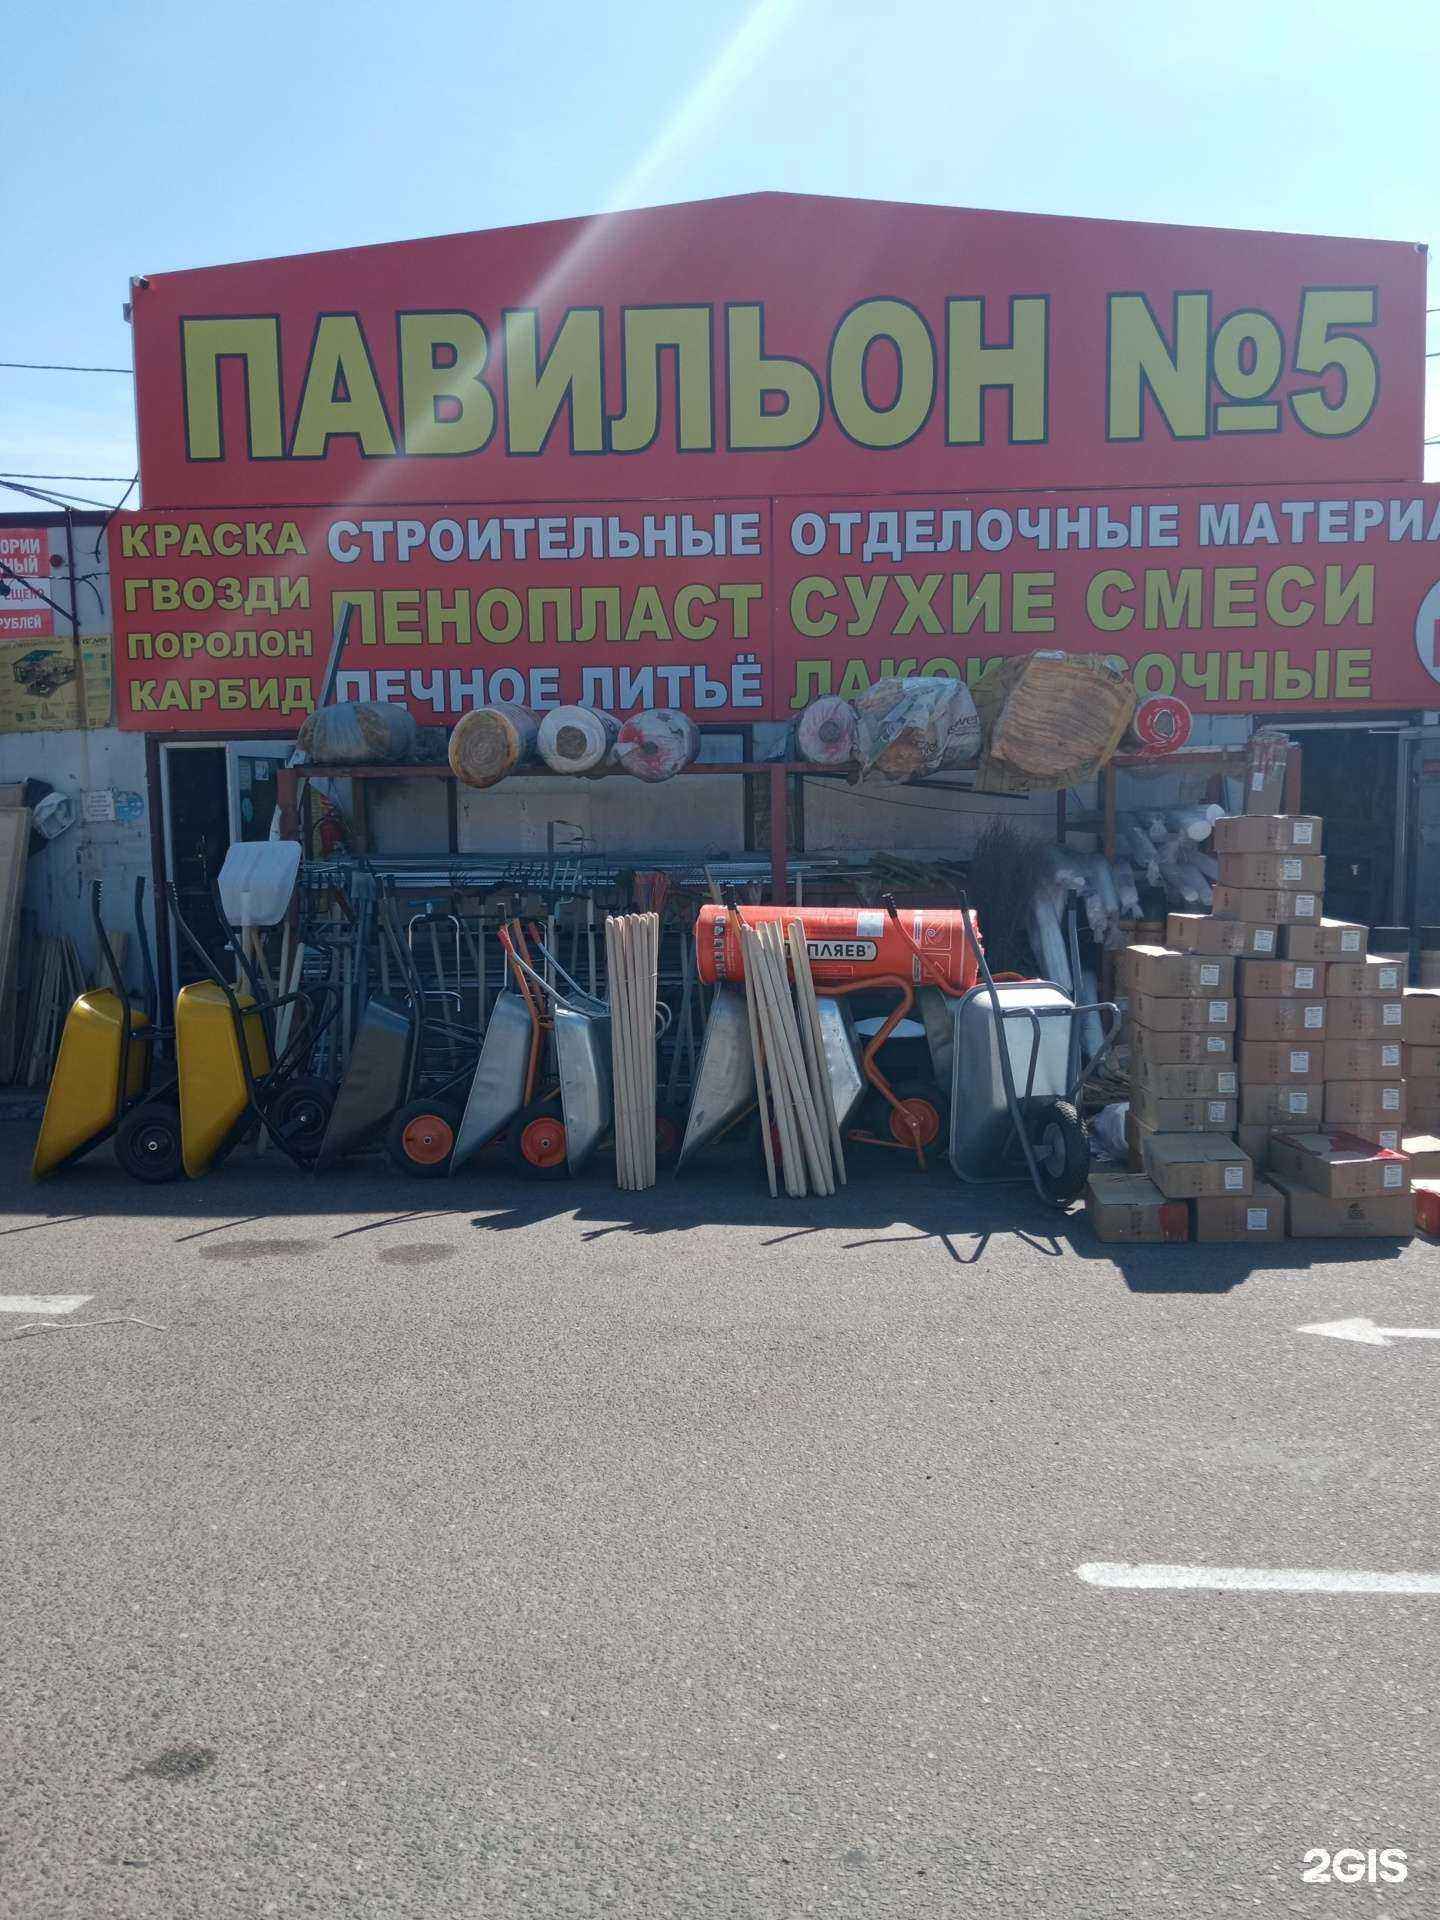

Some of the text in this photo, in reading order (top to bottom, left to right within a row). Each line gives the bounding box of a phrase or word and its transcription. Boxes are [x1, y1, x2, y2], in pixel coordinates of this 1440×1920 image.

[180, 285, 1381, 462] ПАВИЛЬОН №5
[120, 521, 308, 558] КРАСКА
[326, 512, 762, 565] СТРОИТЕЛЬНЫЕ
[789, 504, 1181, 563] ОТДЕЛОЧНЫЕ
[0, 555, 38, 574] НЫЙ
[123, 576, 312, 617] ГВОЗДИ
[330, 582, 763, 646] ПЕНОПЛАСТ
[789, 563, 1377, 639] СУХИЕ СМЕСИ
[126, 629, 314, 660] ПОРОЛОН
[129, 676, 315, 715] КАРБИД
[335, 653, 763, 713] ПЕЧНОЕ ЛИТЬЁ
[790, 646, 1373, 711] ЛАОЧНЫЕ
